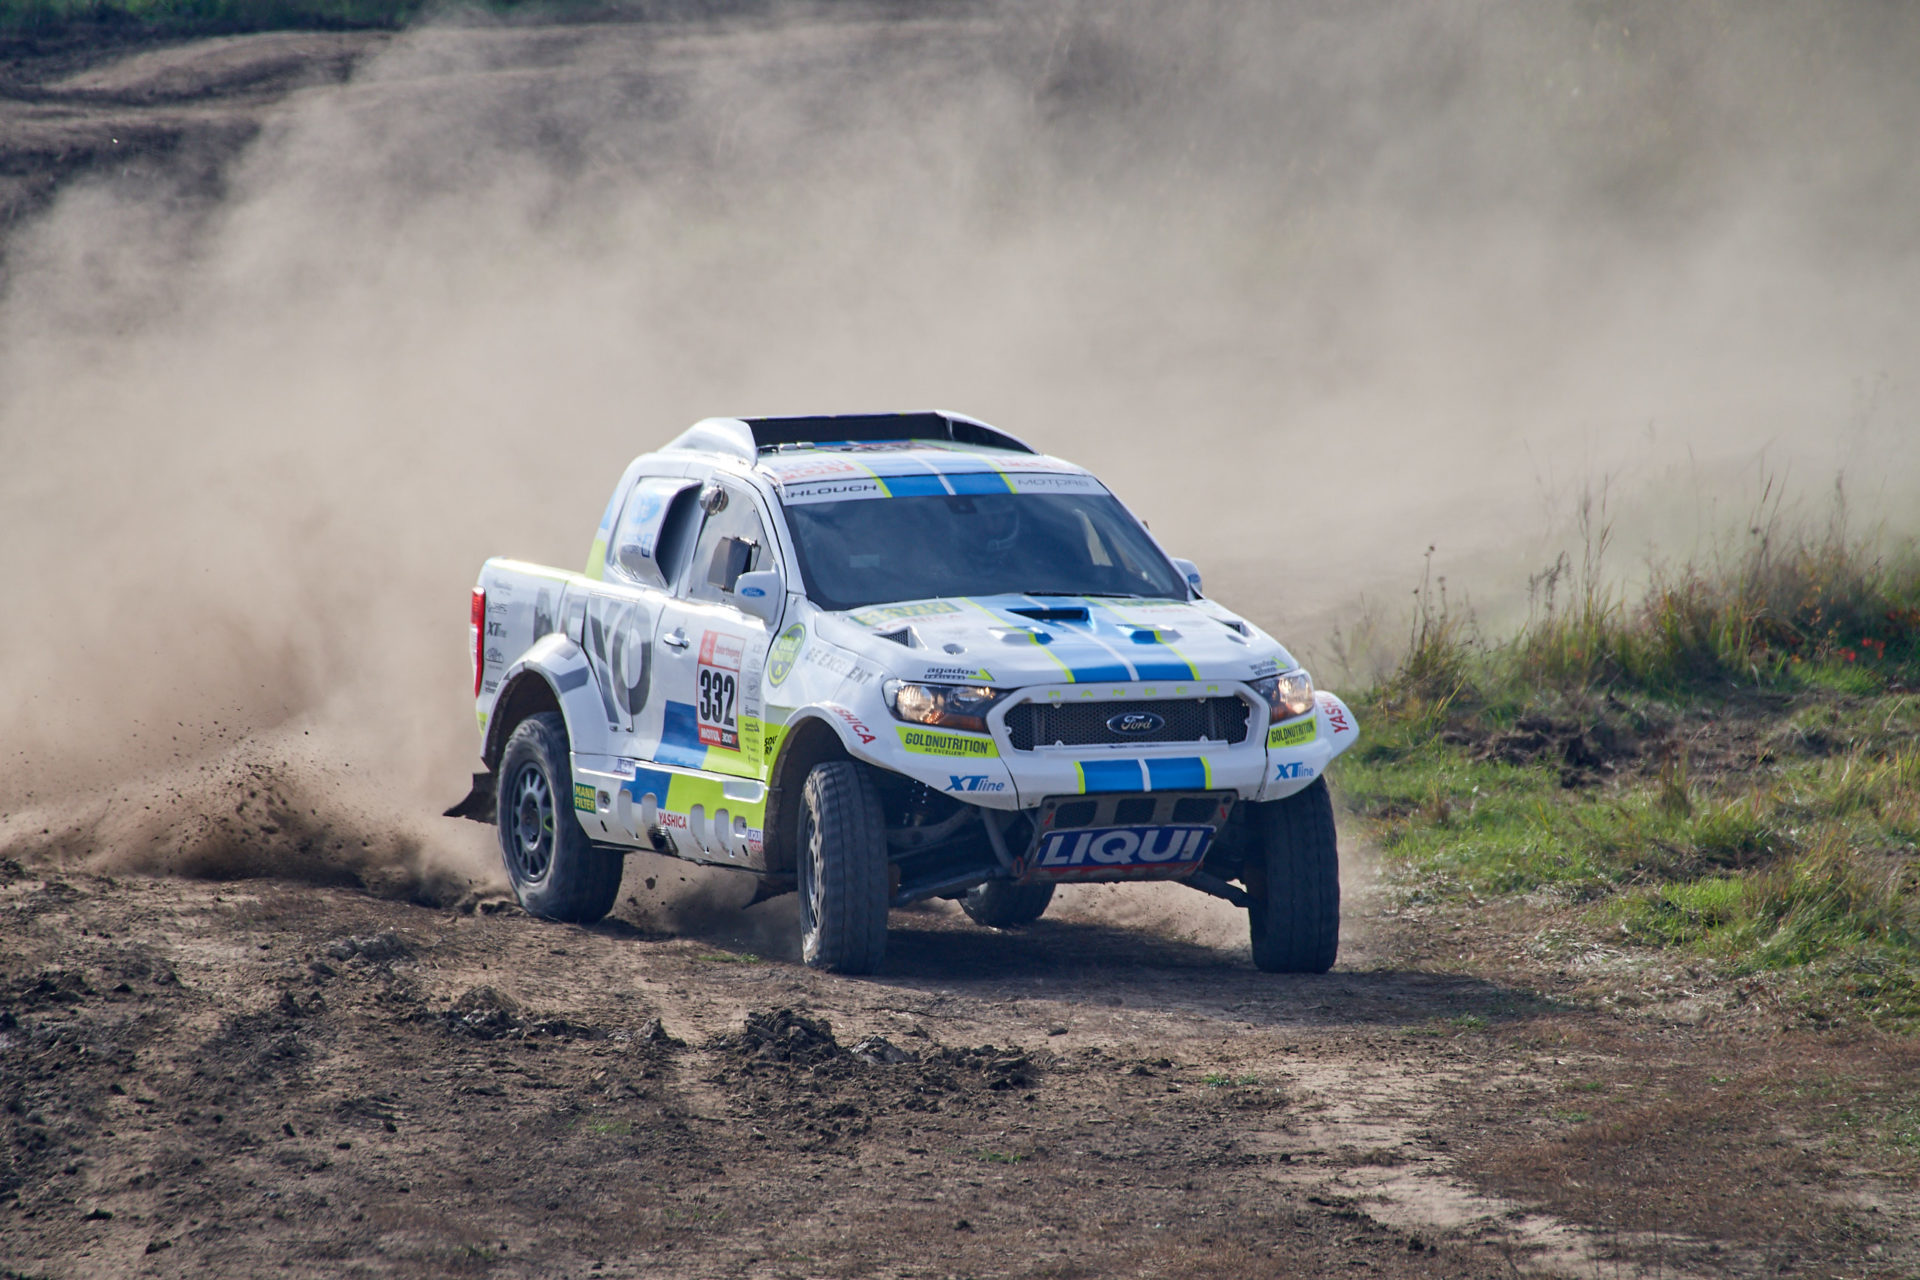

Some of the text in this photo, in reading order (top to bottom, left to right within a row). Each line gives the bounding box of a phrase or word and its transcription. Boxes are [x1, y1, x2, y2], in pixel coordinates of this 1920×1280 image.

[926, 666, 977, 677] agados
[700, 669, 735, 727] 332
[1048, 685, 1218, 699] RANGER
[1121, 714, 1153, 731] Ford
[701, 727, 721, 742] MOTUL
[1271, 720, 1315, 744] GOLDNUTRITION
[905, 732, 989, 755] GOLDNUTRITION
[1275, 761, 1315, 781] XTline
[575, 783, 596, 800] MANN
[944, 774, 1005, 792] XTline
[575, 798, 596, 813] FILTER
[658, 811, 688, 830] YASHICA
[1042, 829, 1204, 865] LIQUI
